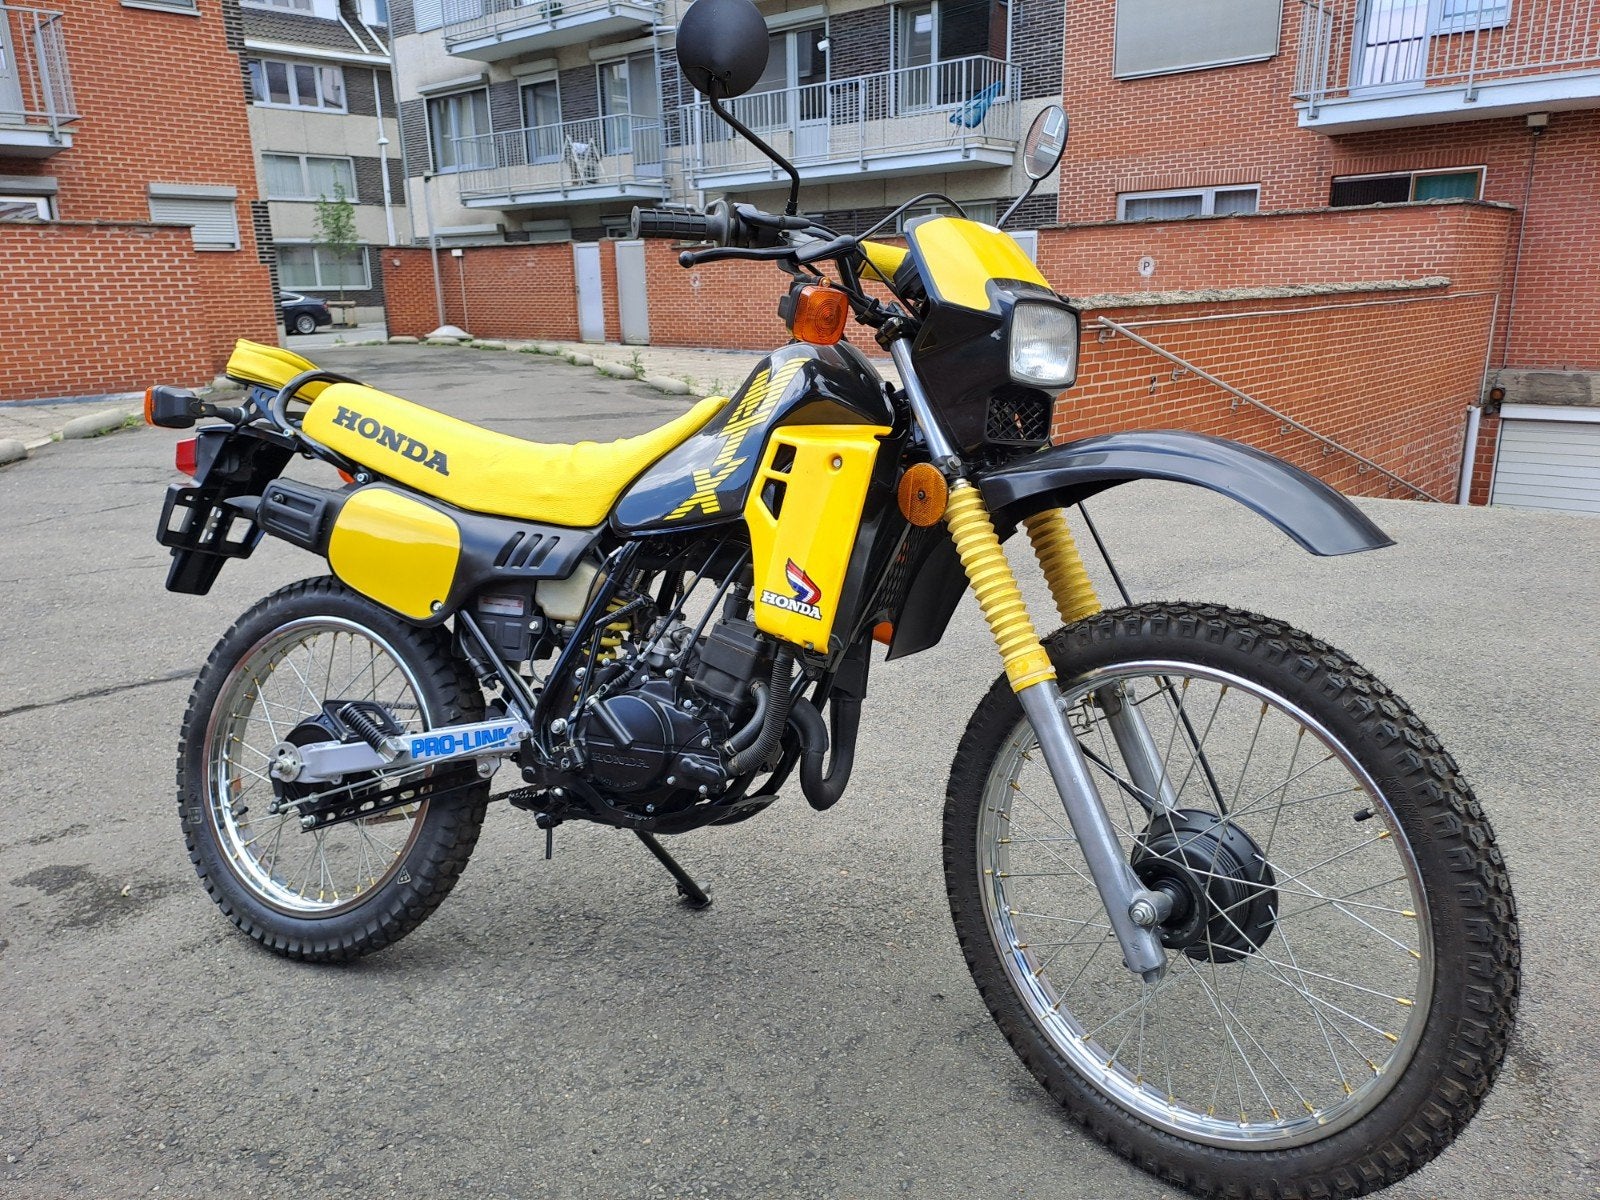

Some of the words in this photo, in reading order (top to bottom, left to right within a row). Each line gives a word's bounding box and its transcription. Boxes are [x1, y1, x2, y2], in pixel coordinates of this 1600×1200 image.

[332, 406, 450, 476] HONDA
[761, 589, 822, 620] HONDA
[412, 726, 516, 758] PRO-LINK
